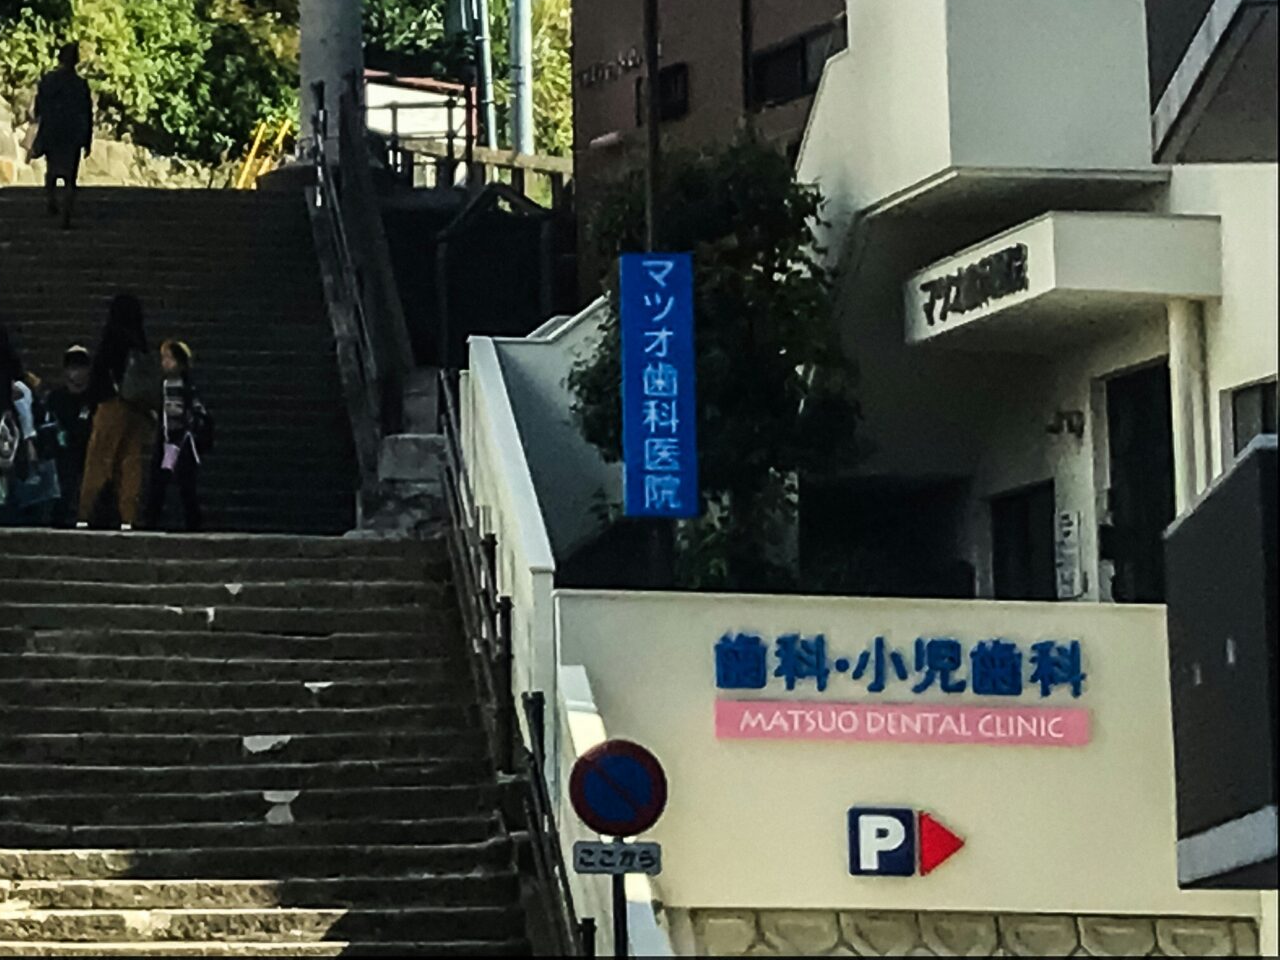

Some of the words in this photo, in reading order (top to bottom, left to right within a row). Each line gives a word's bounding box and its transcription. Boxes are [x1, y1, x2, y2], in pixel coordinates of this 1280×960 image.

[642, 259, 681, 509] マツオ歯科医院
[739, 709, 860, 734] MATSUO
[867, 711, 972, 737] DENTAL
[977, 714, 1065, 739] CLINIC
[579, 848, 657, 868] ここから
[858, 813, 906, 871] P
